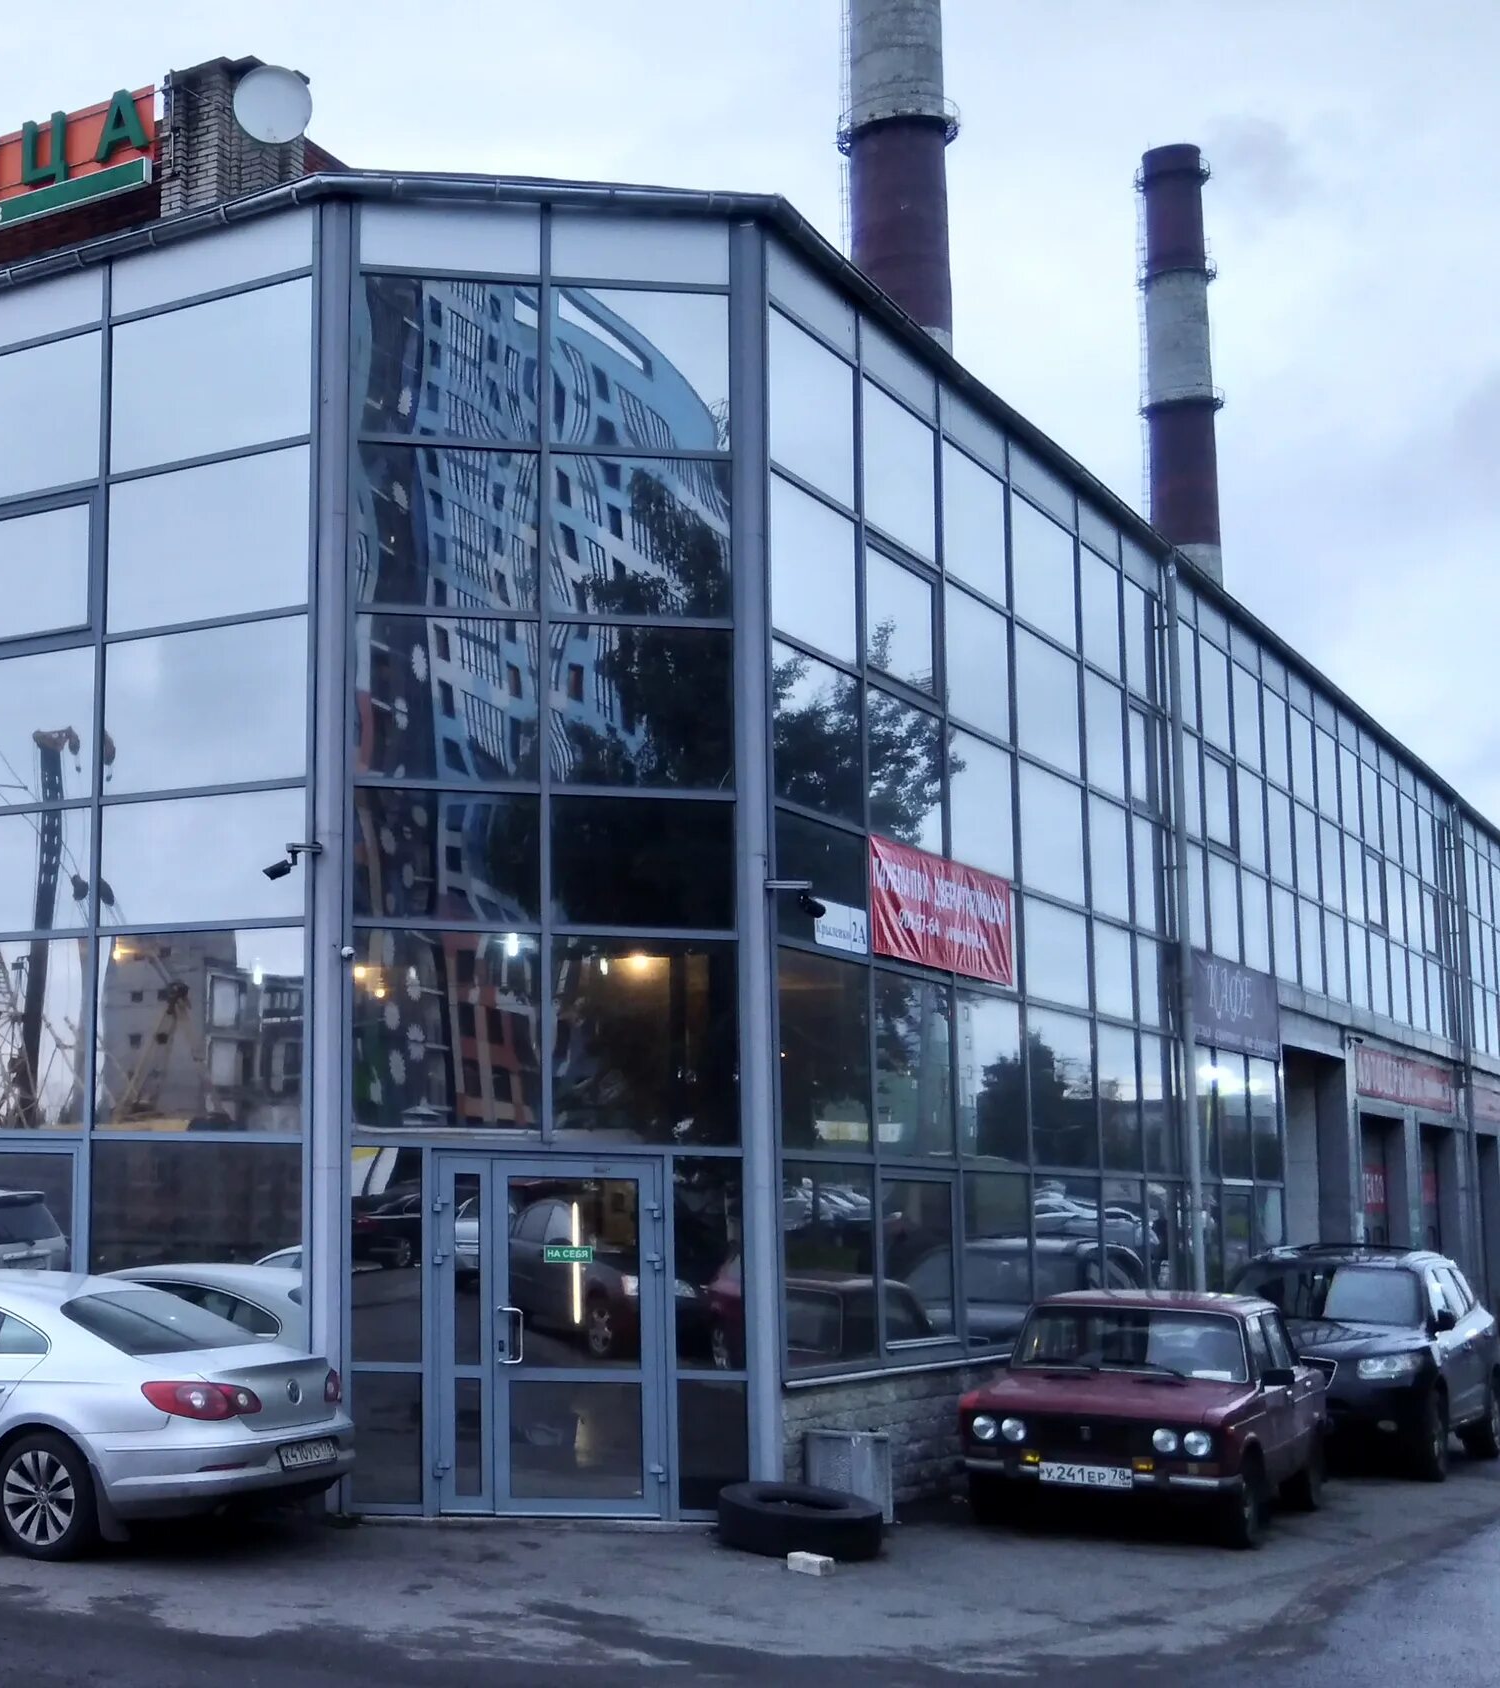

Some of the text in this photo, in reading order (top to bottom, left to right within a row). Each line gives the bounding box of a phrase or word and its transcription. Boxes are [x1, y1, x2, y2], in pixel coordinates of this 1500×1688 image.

[1207, 964, 1253, 1022] КАФЕ
[547, 1250, 588, 1258] НА СЕБЯ
